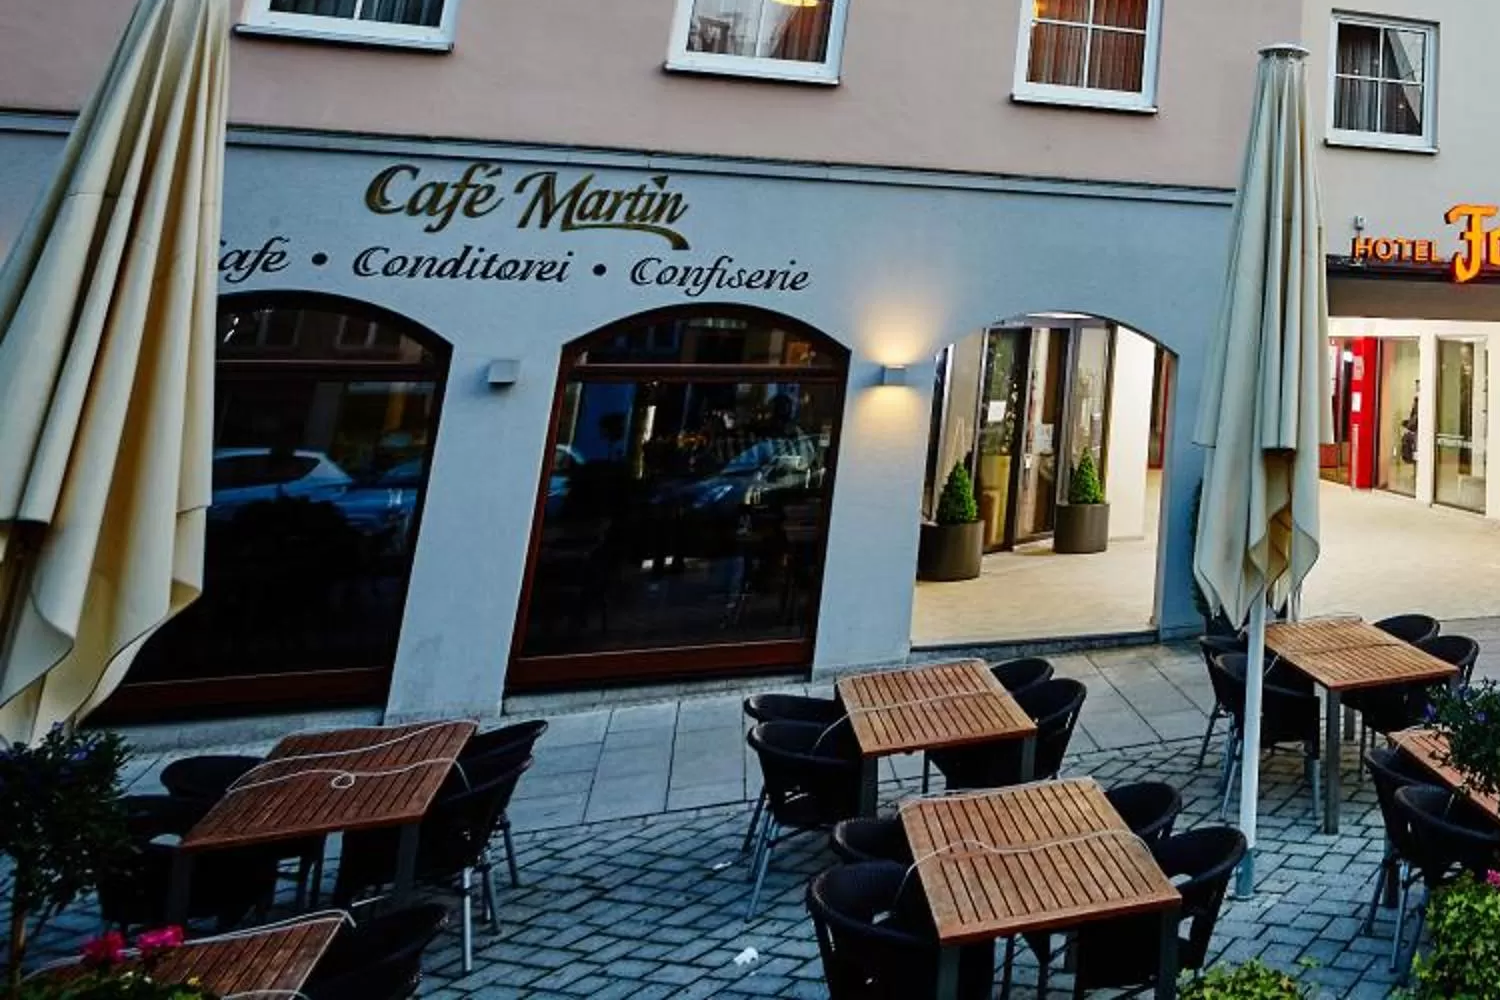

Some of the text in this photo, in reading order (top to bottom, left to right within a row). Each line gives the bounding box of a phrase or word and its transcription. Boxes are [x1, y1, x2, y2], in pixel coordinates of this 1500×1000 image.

[364, 163, 691, 250] Café Martin
[218, 236, 810, 298] afé Conditorei Confiserie
[1352, 236, 1440, 263] HOTEL
